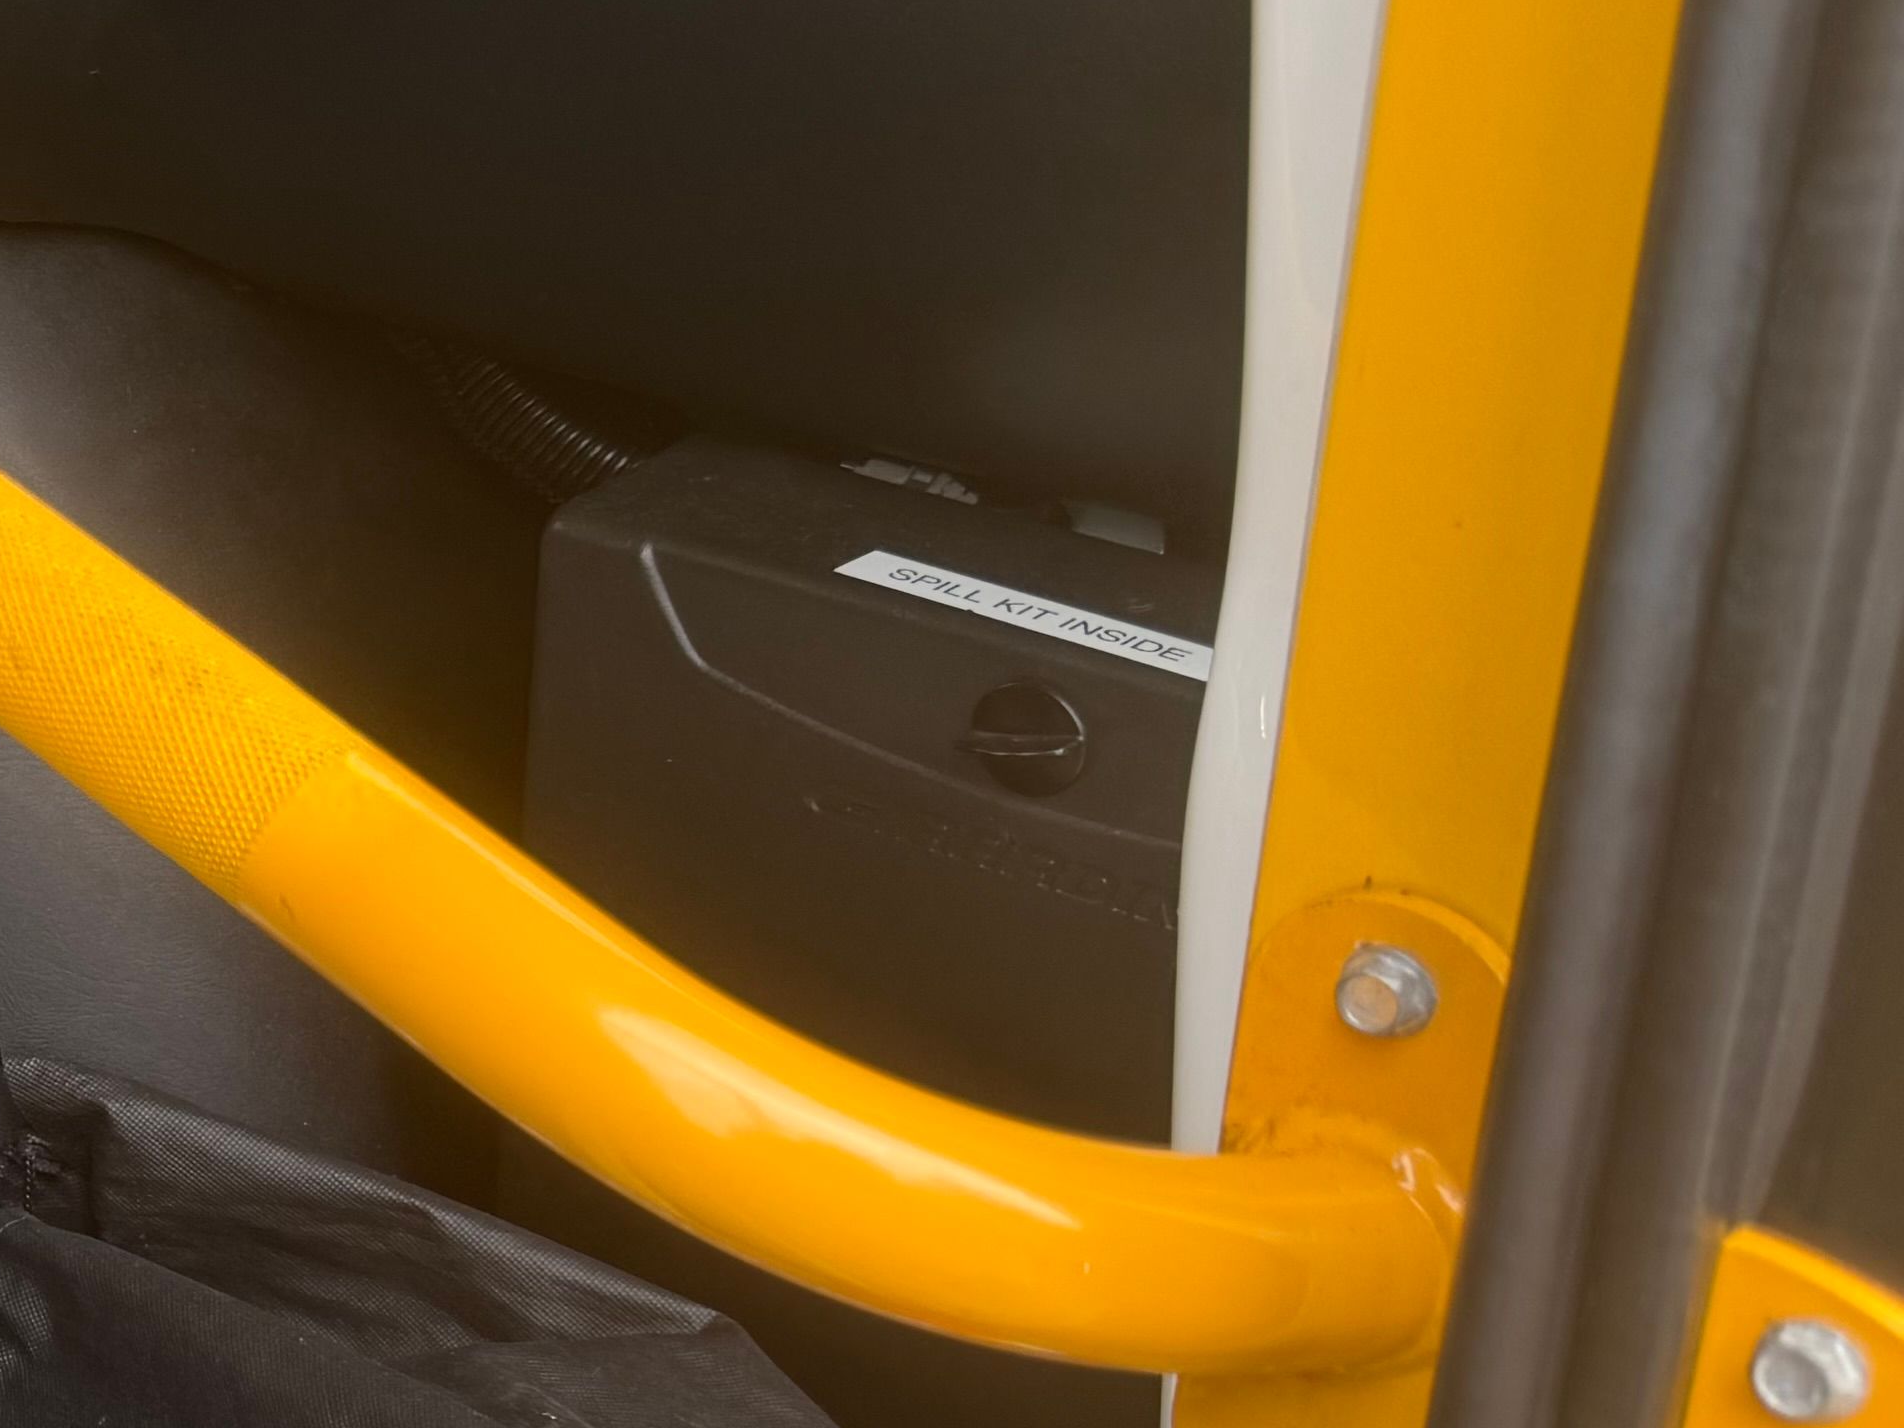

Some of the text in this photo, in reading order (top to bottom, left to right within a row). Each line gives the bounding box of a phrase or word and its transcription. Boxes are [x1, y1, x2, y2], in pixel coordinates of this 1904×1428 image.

[888, 567, 1194, 663] SPILL KIT INSIDE
